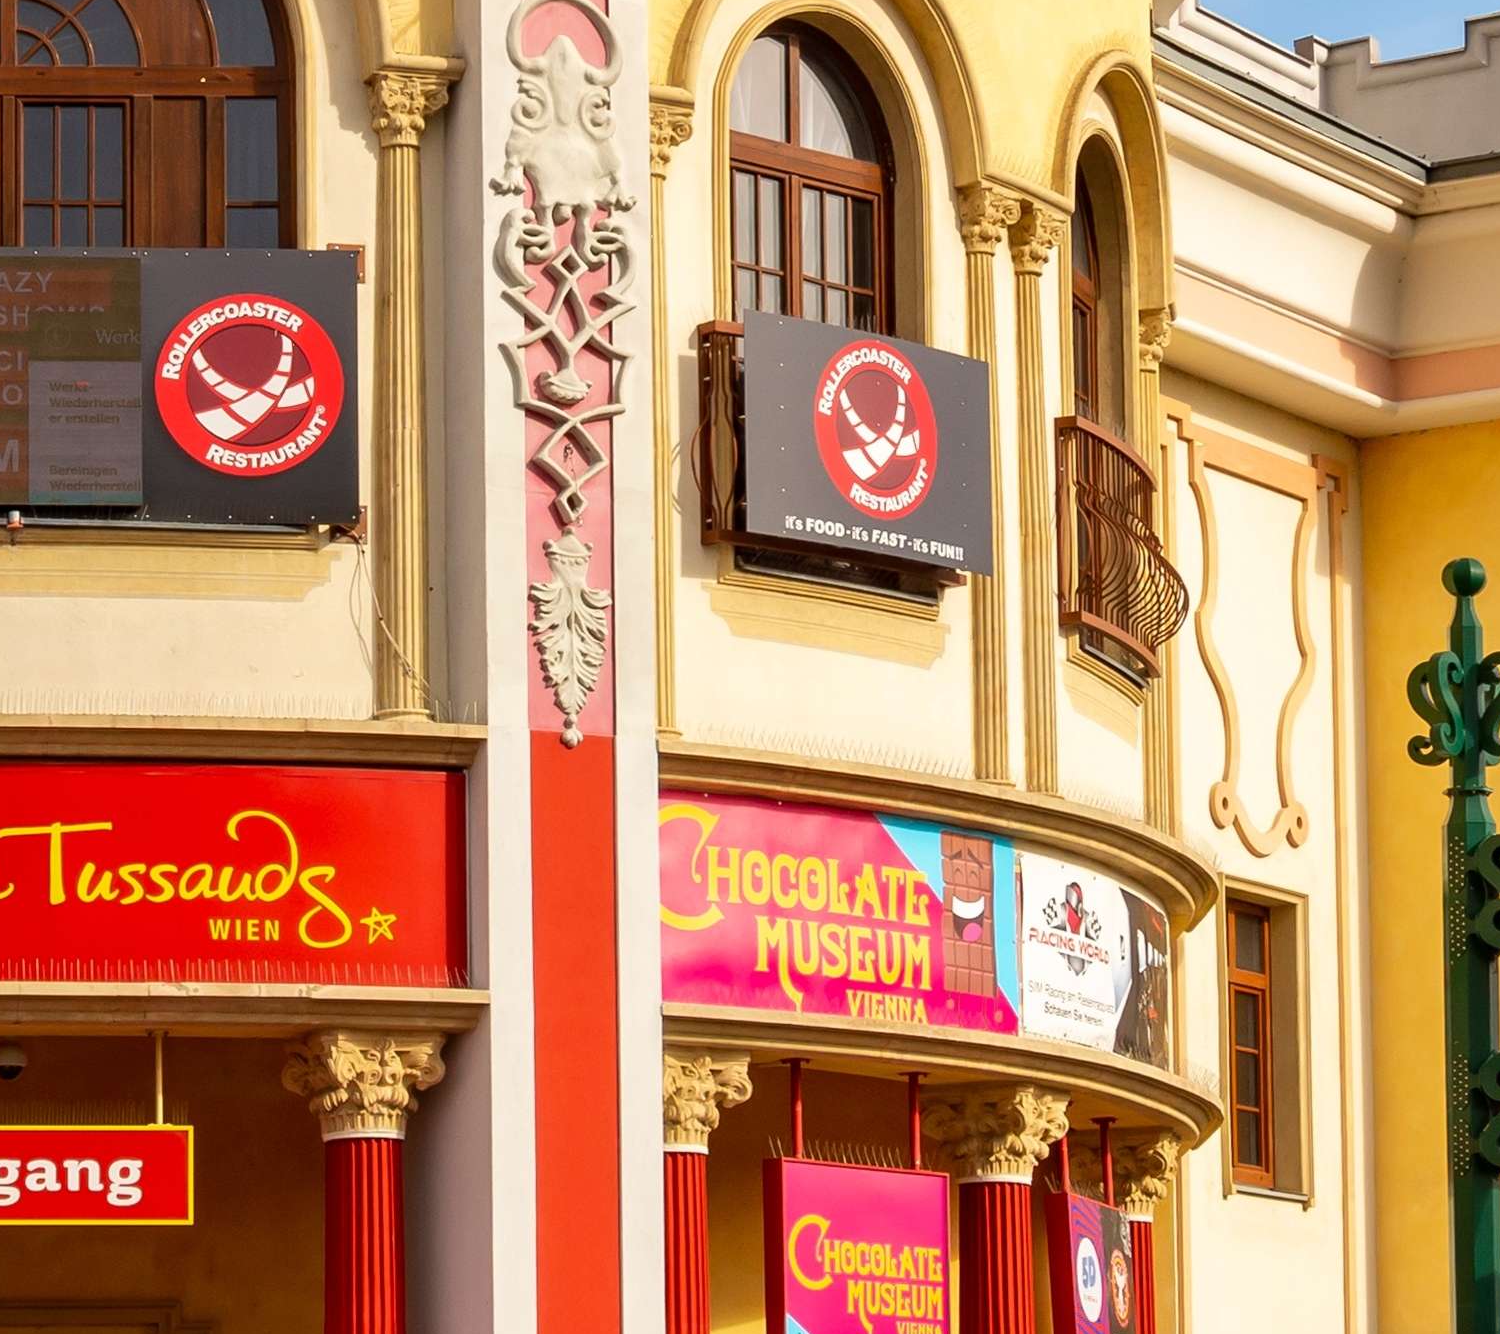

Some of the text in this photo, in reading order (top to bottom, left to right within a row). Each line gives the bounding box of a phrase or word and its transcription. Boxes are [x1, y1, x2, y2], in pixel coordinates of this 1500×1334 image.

[162, 301, 303, 380] ROLLERCOASTER
[817, 347, 911, 415] ROLLERCOASTER
[205, 414, 327, 469] RESTAURANT
[850, 465, 930, 513] RESTAURANT
[805, 517, 845, 537] FOOD
[871, 528, 908, 549] FAST
[659, 803, 932, 931] CHOCOLATE
[209, 918, 280, 942] WIEN
[1029, 927, 1111, 965] RACING WORLD
[754, 915, 933, 1015] MUSEUM
[845, 990, 929, 1025] VIENNA
[787, 1213, 944, 1291] CHOCOLATE
